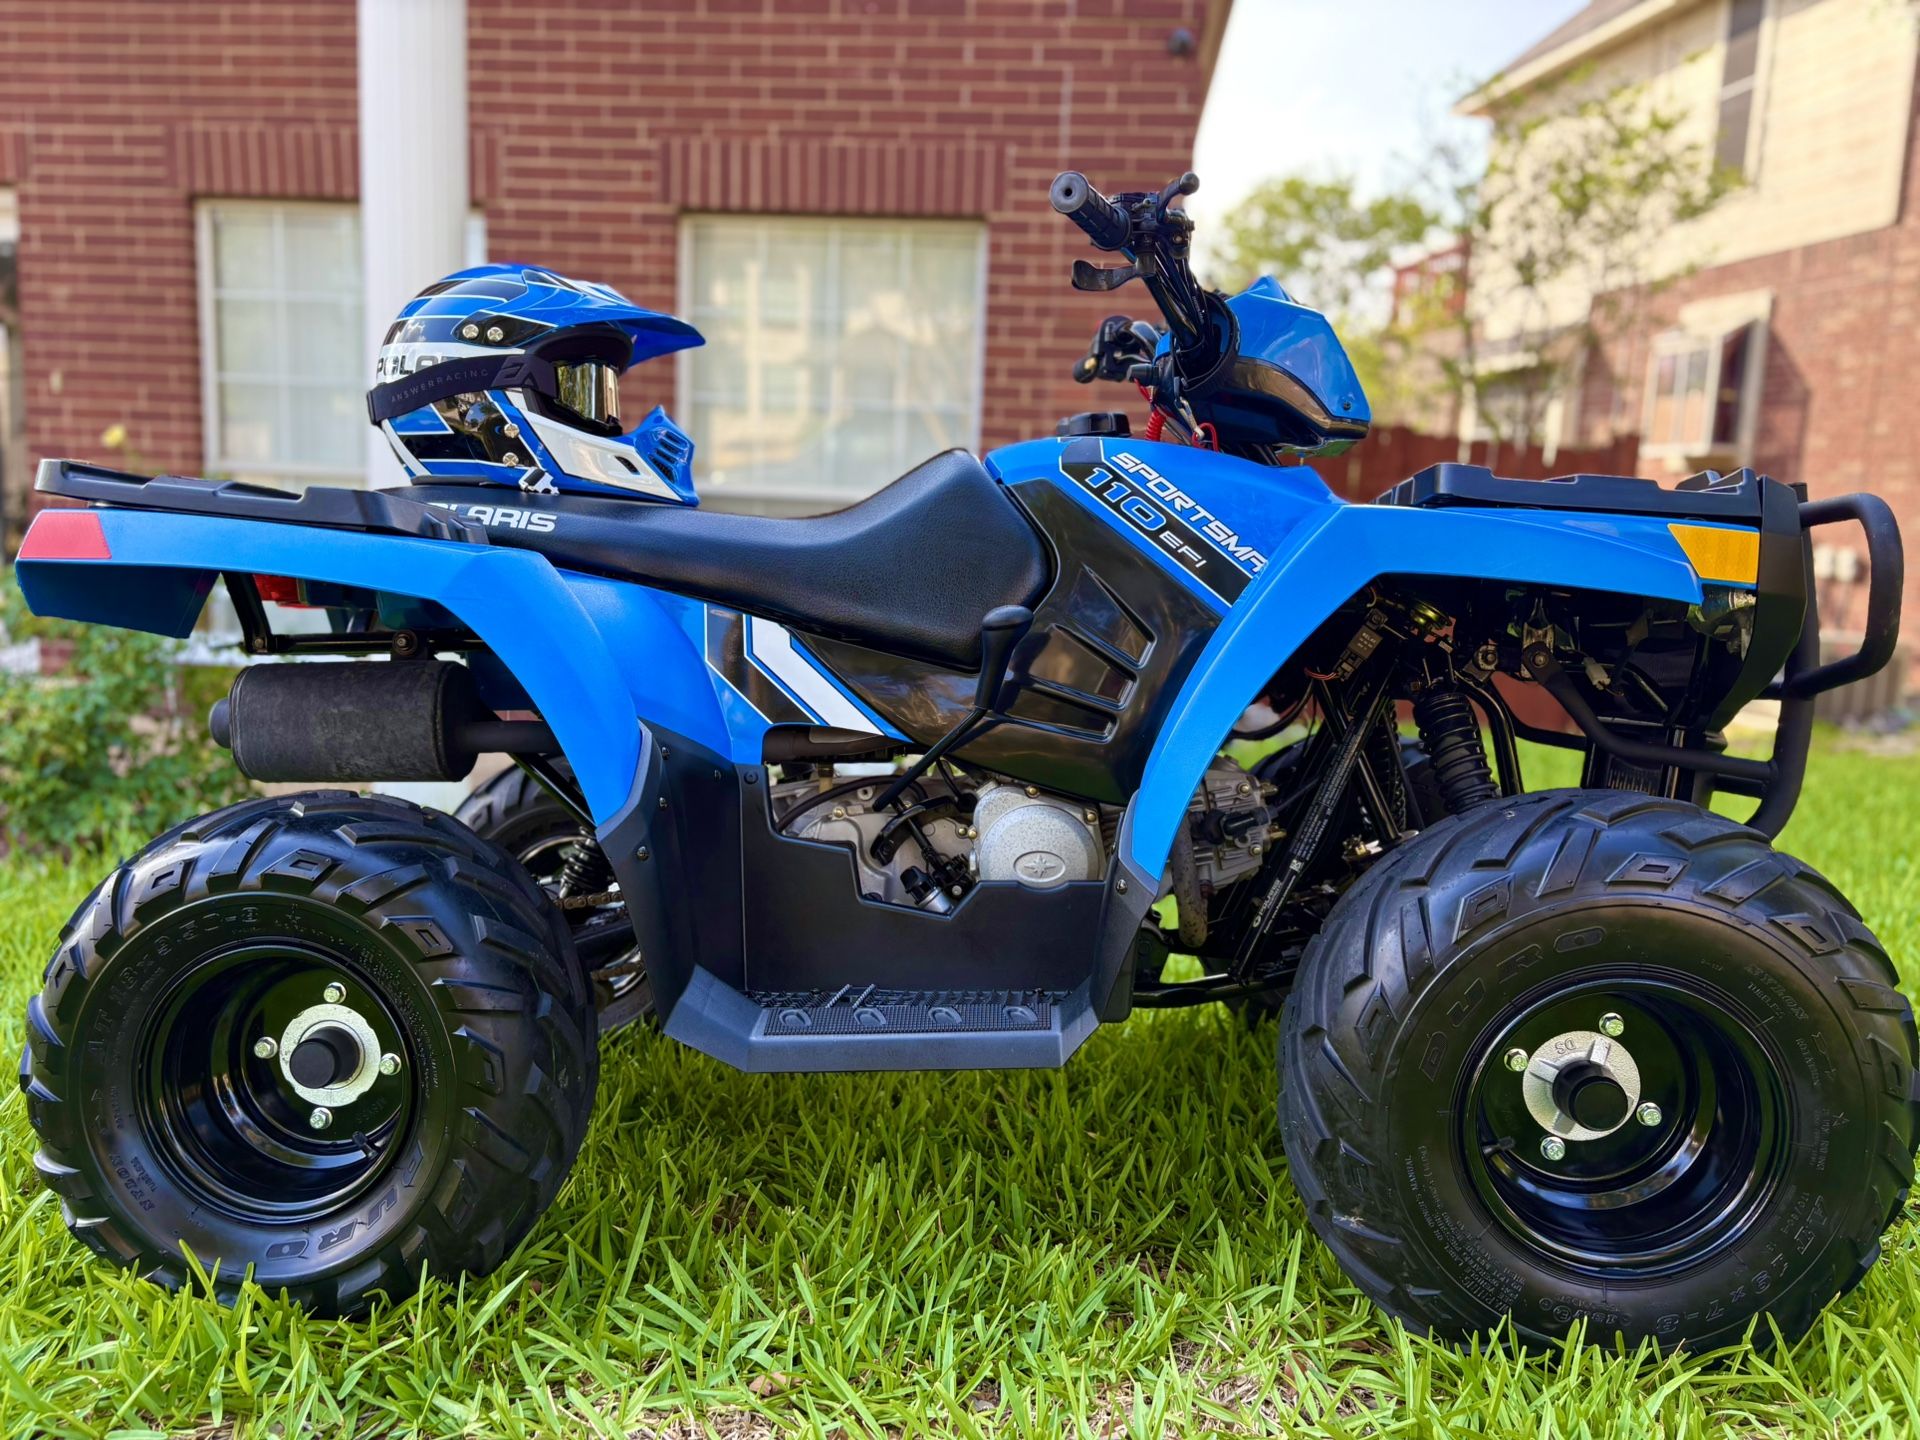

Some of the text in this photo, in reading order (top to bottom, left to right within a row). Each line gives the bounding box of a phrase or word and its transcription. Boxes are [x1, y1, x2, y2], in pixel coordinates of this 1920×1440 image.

[377, 355, 461, 376] POLA
[1084, 466, 1208, 568] 110 EFI
[1417, 926, 1606, 1083] DURO
[265, 1141, 425, 1262] DURO
